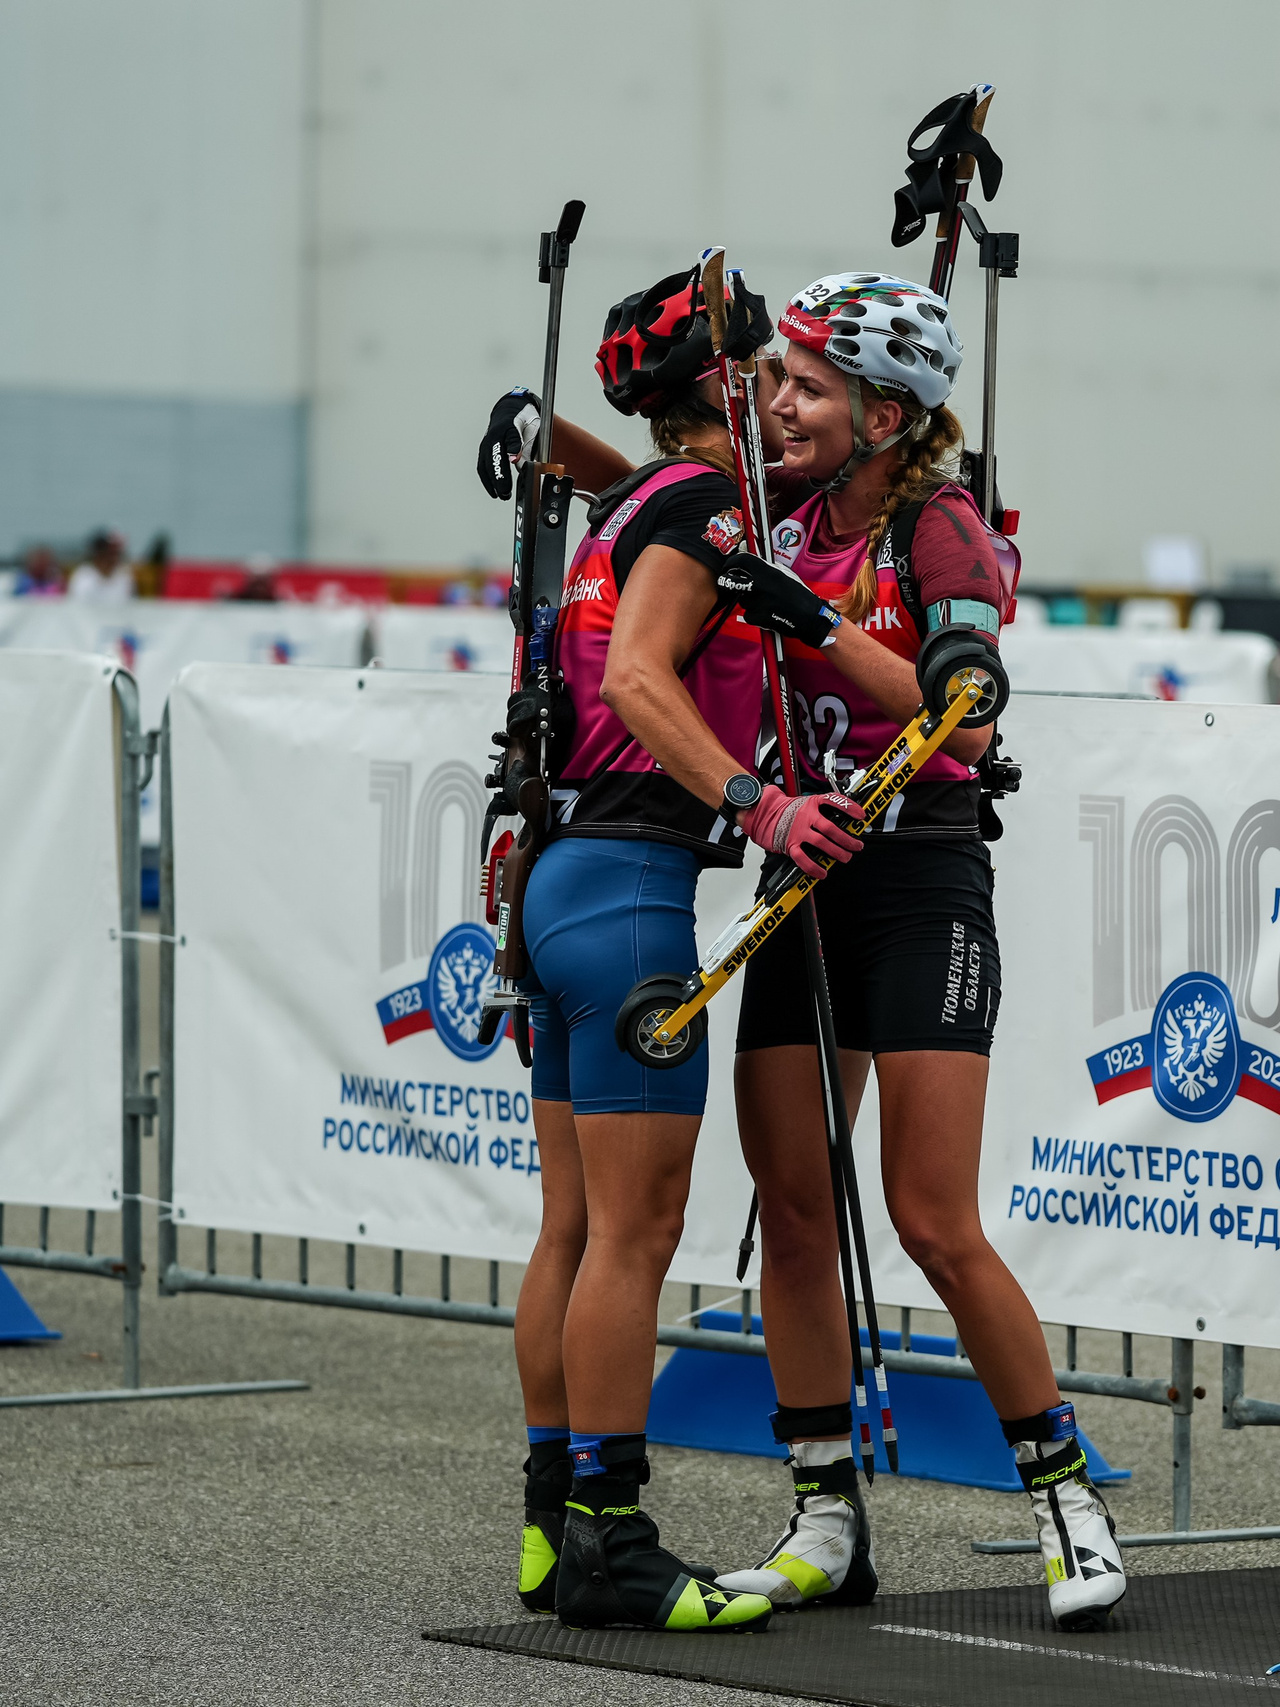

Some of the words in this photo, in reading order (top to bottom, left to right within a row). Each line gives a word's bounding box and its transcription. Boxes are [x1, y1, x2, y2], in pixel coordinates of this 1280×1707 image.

[804, 283, 831, 303] 32
[851, 761, 916, 834] SWENOR
[500, 910, 509, 937] ATOM
[722, 904, 787, 976] SWENOR
[941, 920, 965, 1024] ТЮМЕНСКАЯ
[964, 941, 981, 1012] ОБЛАСТЬ
[388, 985, 423, 1017] 1923
[1103, 1042, 1145, 1076] 1923
[340, 1072, 530, 1124] МИНИСТЕРСТВО
[322, 1117, 480, 1168] РОССИЙСКОЙ
[1031, 1136, 1264, 1191] МИНИСТЕРСТВО
[1008, 1182, 1200, 1238] РОССИЙСКОЙ
[578, 1452, 589, 1460] 26
[1031, 1455, 1087, 1487] FISCHER
